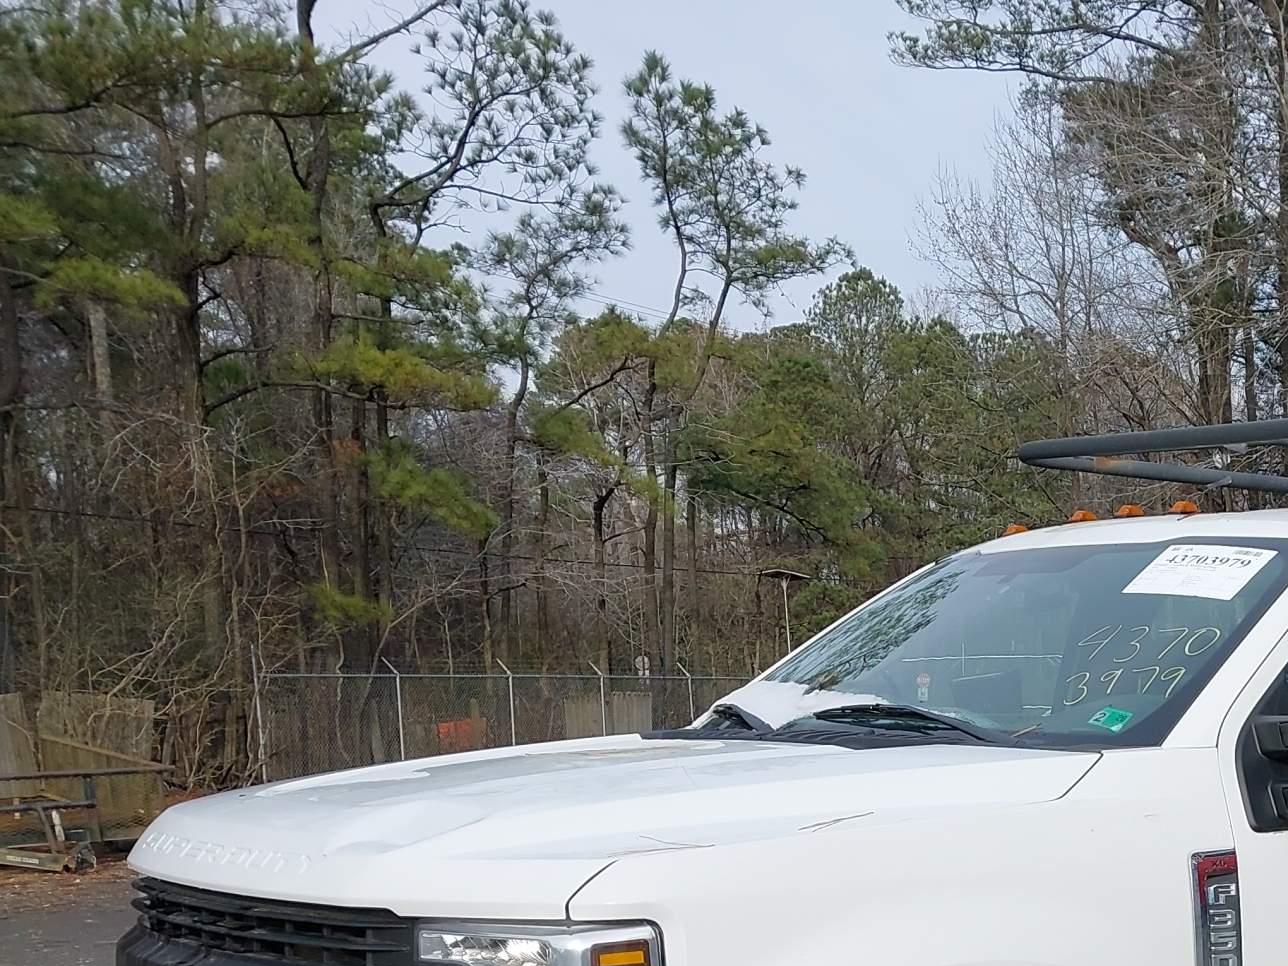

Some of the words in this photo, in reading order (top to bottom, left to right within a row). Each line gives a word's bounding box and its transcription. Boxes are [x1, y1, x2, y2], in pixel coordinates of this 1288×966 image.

[1166, 554, 1252, 569] 43703979
[1077, 624, 1221, 663] 4370
[1063, 666, 1187, 705] 3979
[142, 831, 225, 865] SUPER
